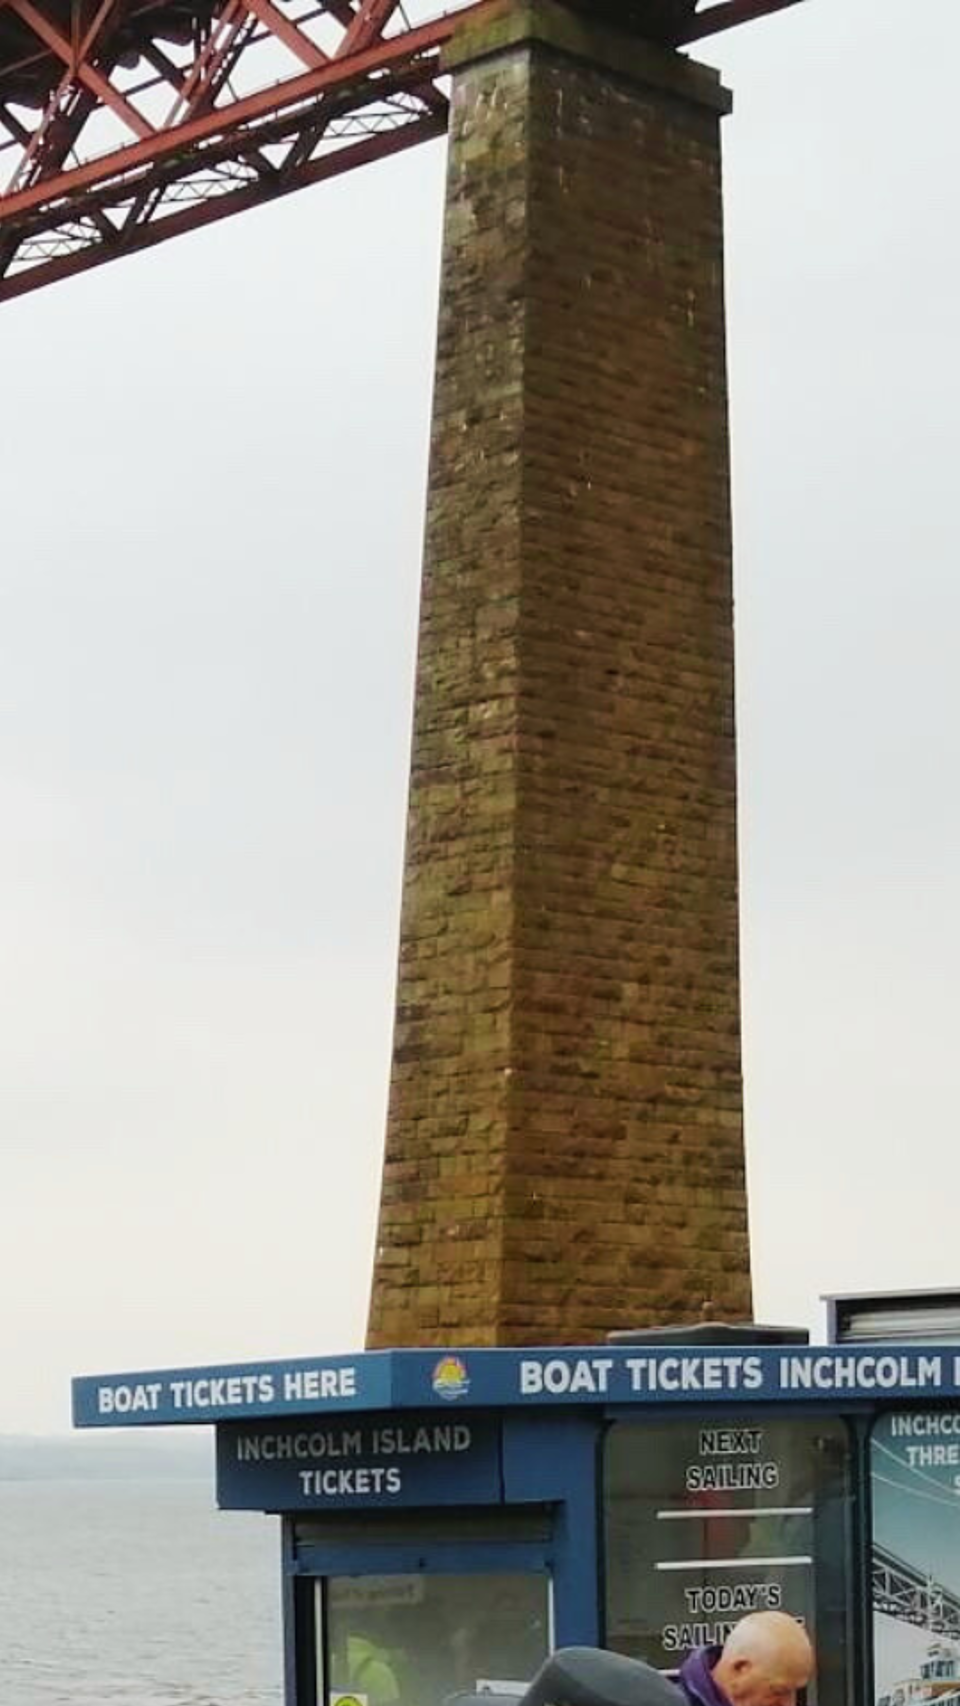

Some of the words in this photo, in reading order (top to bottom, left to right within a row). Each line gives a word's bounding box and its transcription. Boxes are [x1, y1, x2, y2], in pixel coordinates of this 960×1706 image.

[520, 1359, 613, 1394] BOAT
[626, 1357, 764, 1391] TICKETS
[780, 1356, 942, 1388] INCHCOLM
[98, 1383, 162, 1413] BOAT
[170, 1374, 275, 1408] TICKETS
[283, 1367, 358, 1401] HERE
[237, 1430, 362, 1461] INCHCOLM
[372, 1425, 471, 1454] ISLAND
[699, 1428, 763, 1455] NEXT
[905, 1444, 960, 1467] THRE
[299, 1467, 401, 1495] TICKETS
[686, 1462, 780, 1491] SAILING
[685, 1583, 782, 1613] TODAY'S
